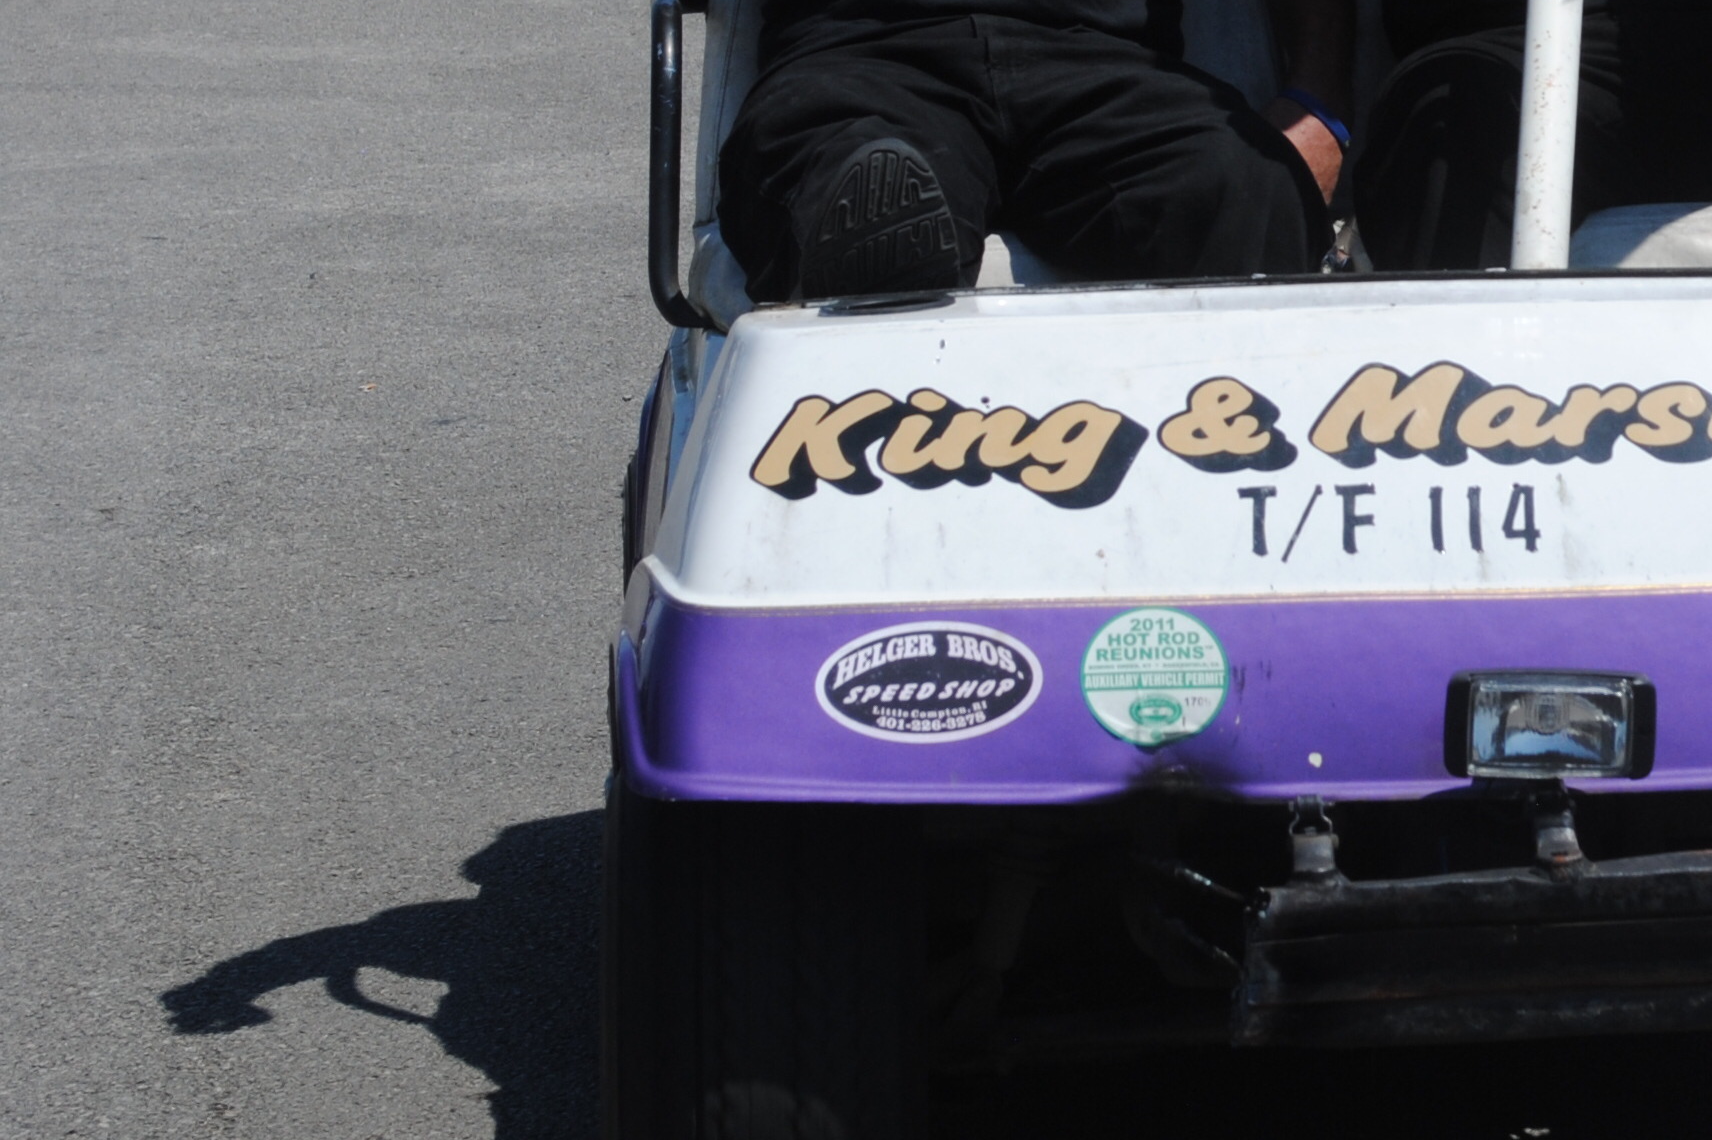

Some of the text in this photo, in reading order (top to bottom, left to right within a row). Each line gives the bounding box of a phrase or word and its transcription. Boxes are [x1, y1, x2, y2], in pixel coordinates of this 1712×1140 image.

[749, 388, 1149, 510] King
[1157, 376, 1298, 473] &
[1238, 481, 1541, 562] T/F 114
[1130, 617, 1175, 632] 2011
[1108, 632, 1200, 647] HOT ROD
[832, 633, 1024, 690] HELGER BROS.
[1085, 672, 1225, 689] AUXILIARY VEHICLE PERMIT
[843, 678, 1016, 705] SPEED SHOP
[872, 705, 909, 718] Little
[911, 703, 971, 719] Compton,
[876, 712, 986, 732] 401-226-3278
